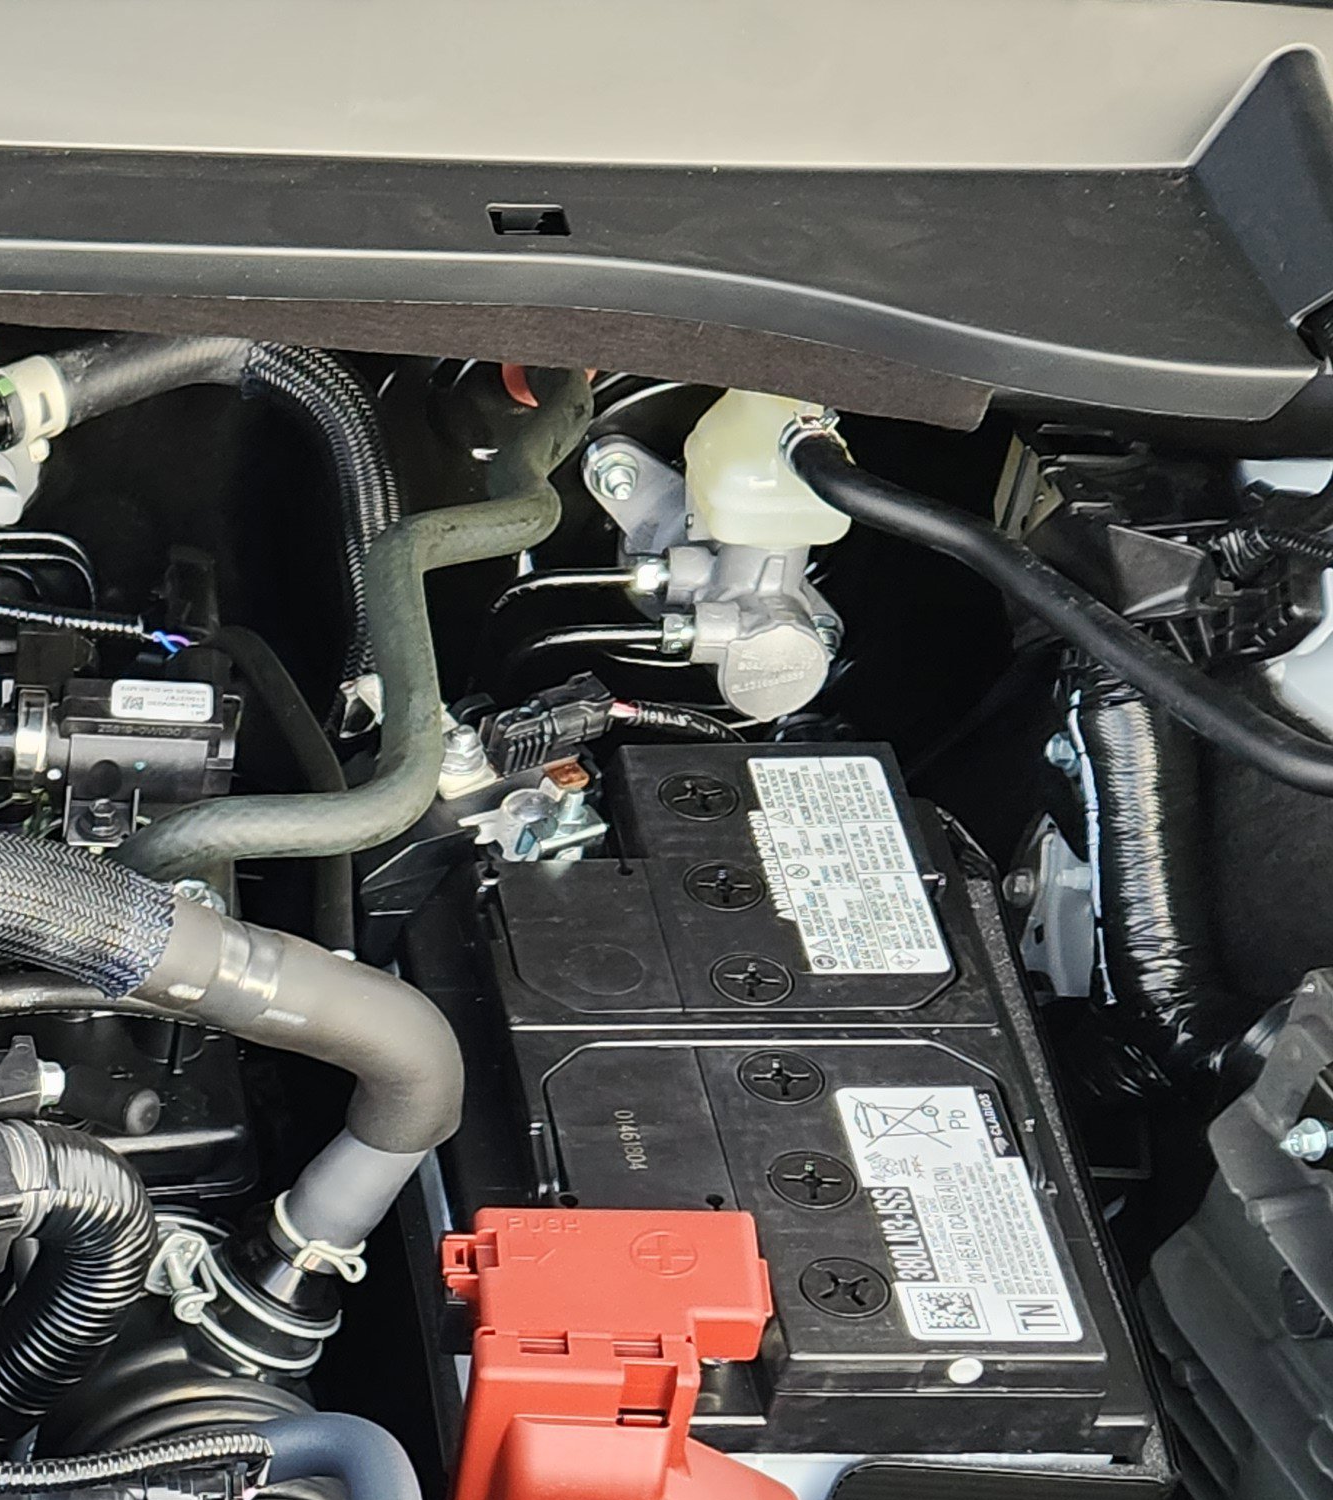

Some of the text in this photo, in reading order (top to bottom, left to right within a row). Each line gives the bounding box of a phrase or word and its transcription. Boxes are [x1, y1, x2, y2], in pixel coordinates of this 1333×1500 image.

[948, 1108, 971, 1131] Pb
[977, 1092, 1003, 1137] CLARIOS
[505, 1216, 582, 1236] PUSH
[870, 1187, 937, 1281] 380LN3-ISS
[1014, 1303, 1062, 1331] TN
